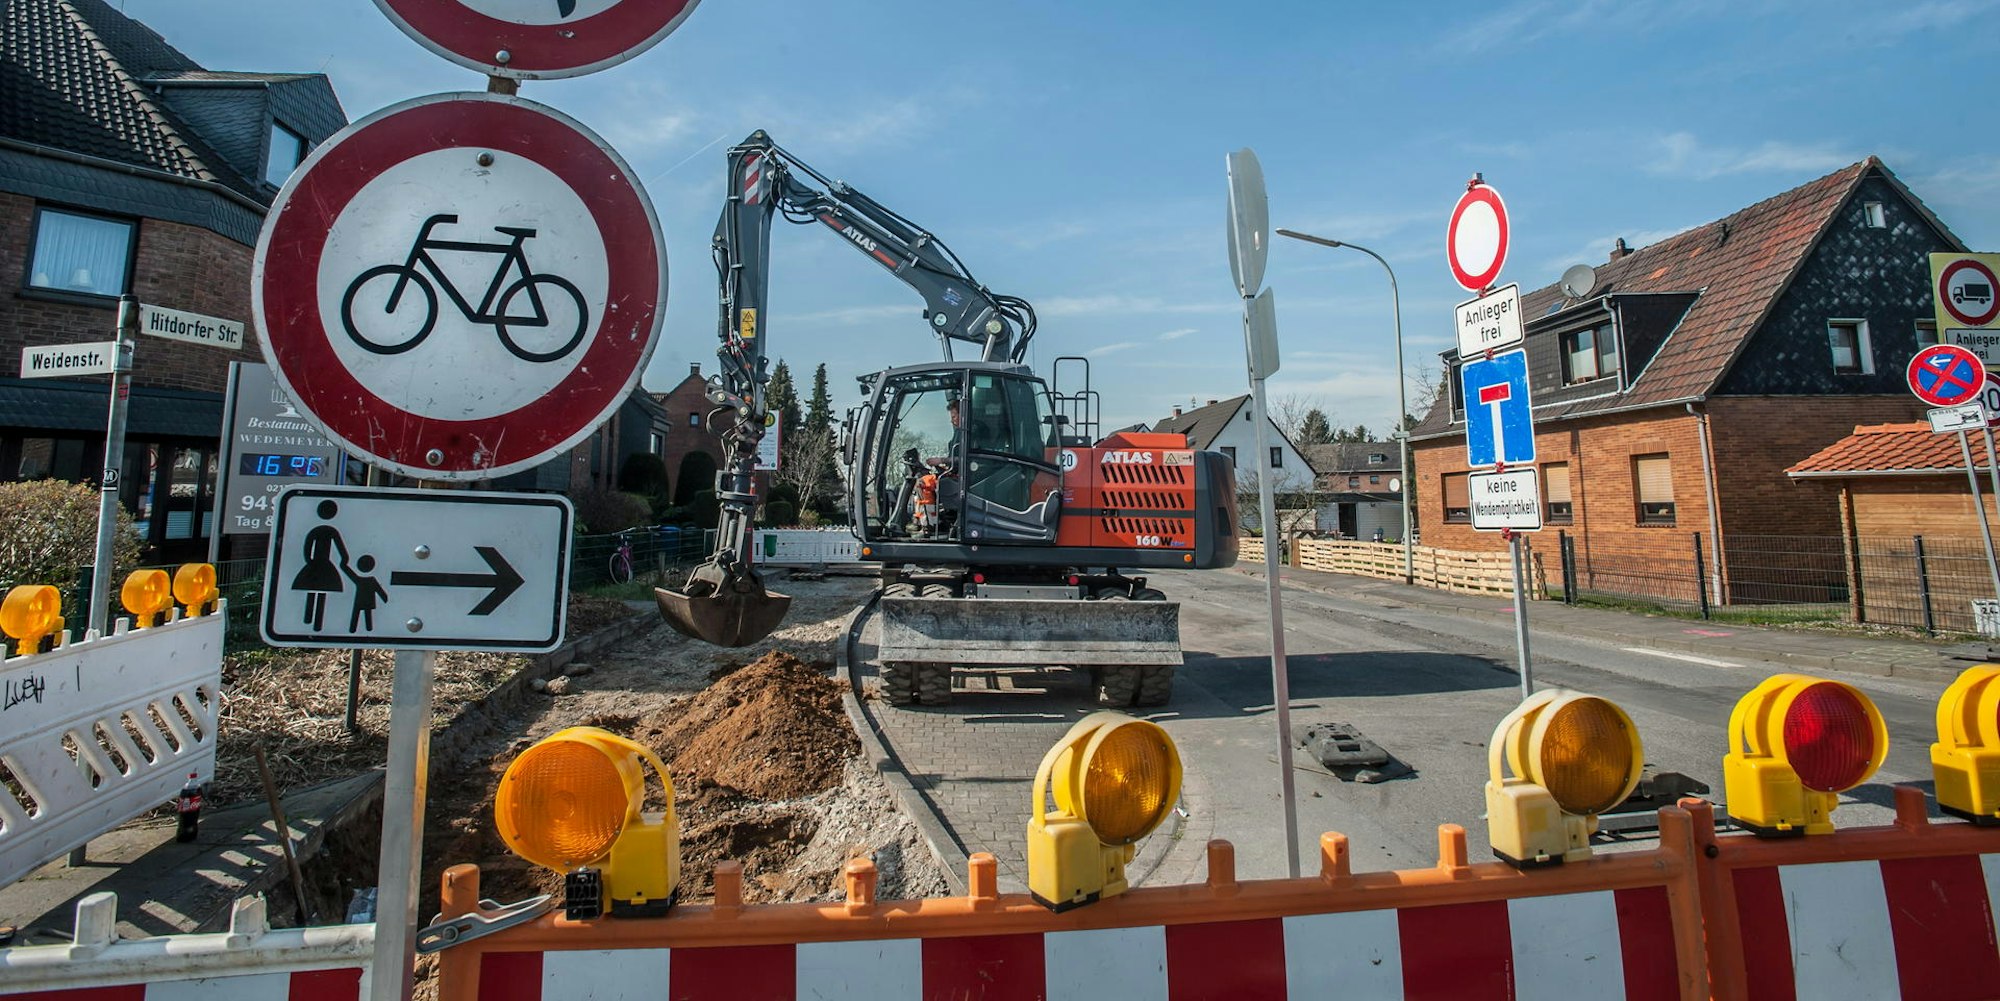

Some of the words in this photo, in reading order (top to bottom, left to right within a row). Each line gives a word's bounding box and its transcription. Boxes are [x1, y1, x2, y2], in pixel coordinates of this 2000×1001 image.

[841, 225, 877, 252] ATLAS
[1465, 298, 1513, 326] Anlieger
[151, 311, 214, 339] Hitdorfer
[218, 324, 237, 343] Str.
[1480, 322, 1501, 342] frei
[1956, 333, 1999, 347] Anlieger
[32, 351, 103, 370] Weidenstr.
[257, 456, 281, 475] 16
[1101, 451, 1152, 464] ATLAS
[1486, 478, 1517, 493] keine
[1474, 498, 1536, 519] Wendemöglichkeit
[235, 515, 260, 529] Tag
